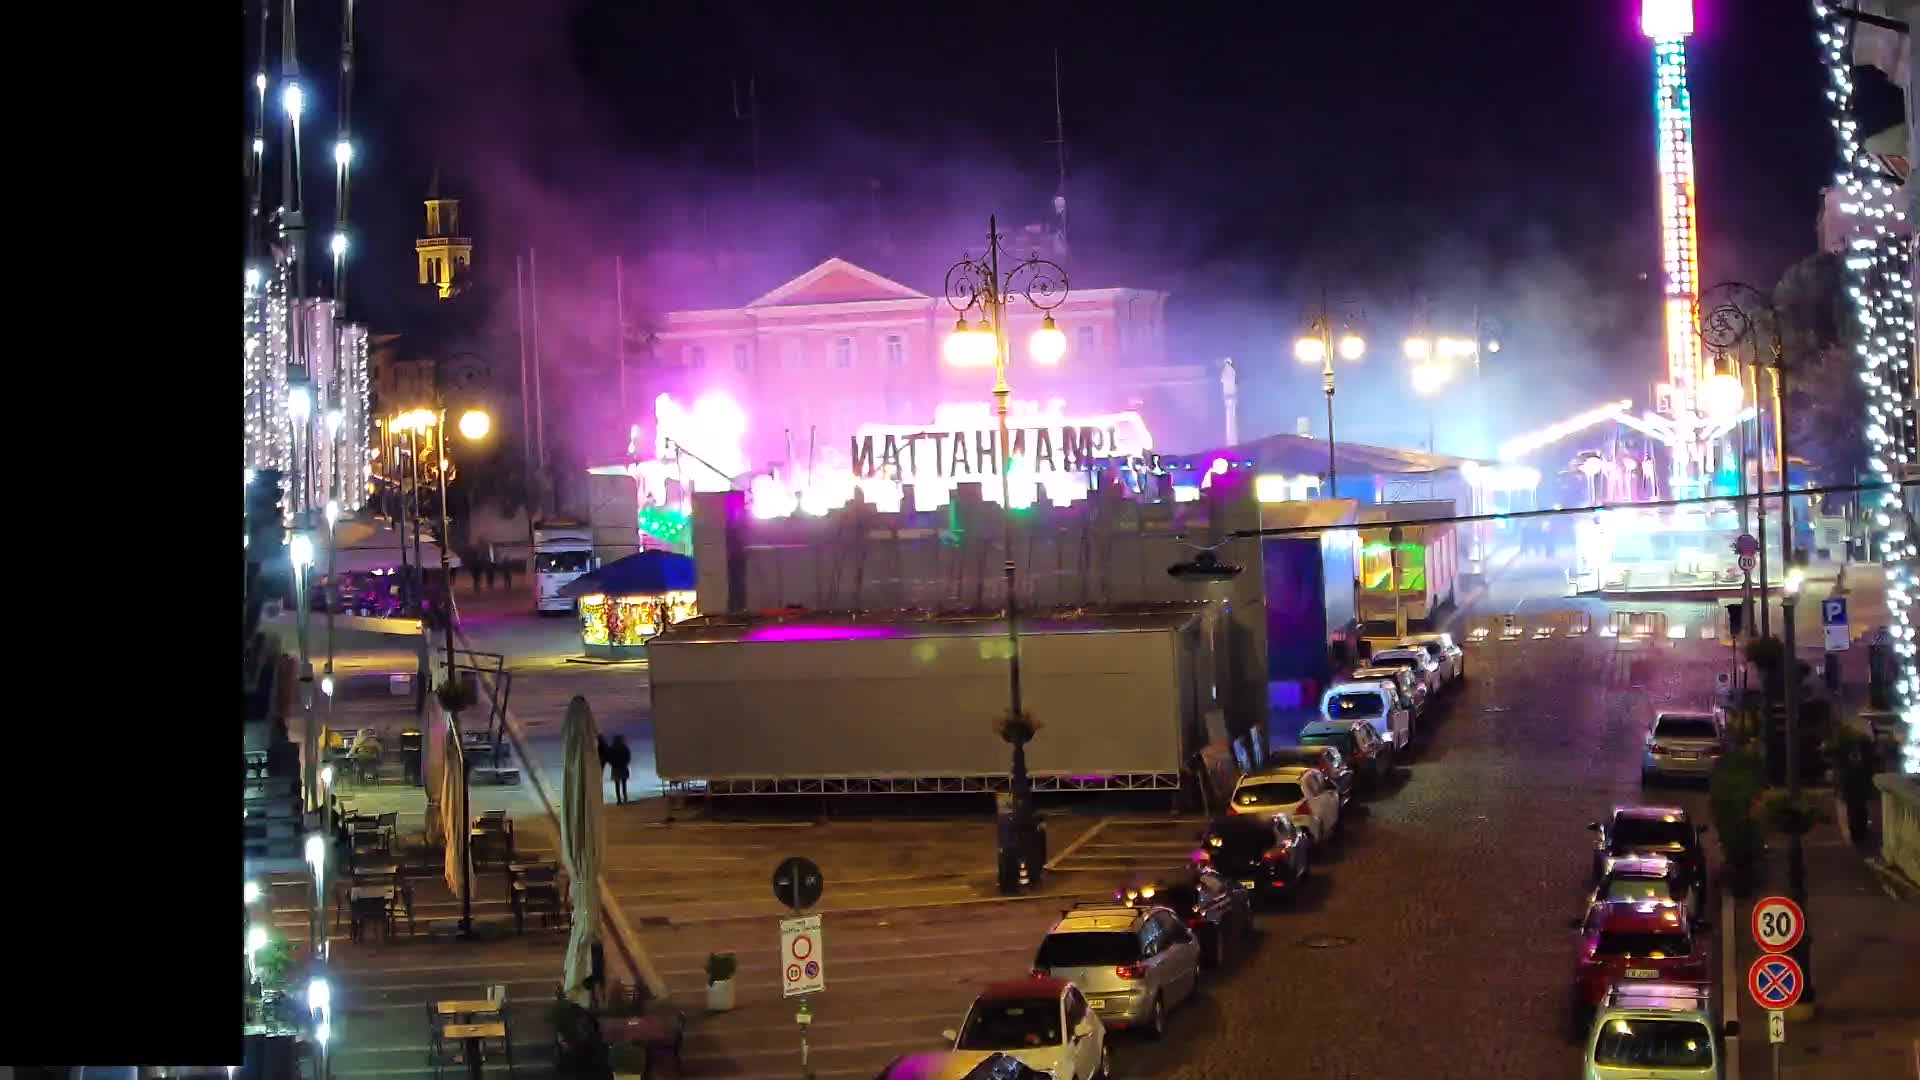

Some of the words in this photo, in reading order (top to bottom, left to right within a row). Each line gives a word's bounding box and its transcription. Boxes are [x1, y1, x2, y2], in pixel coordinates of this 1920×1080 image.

[1742, 557, 1753, 566] 20
[1825, 603, 1841, 621] P
[1762, 912, 1791, 937] 30
